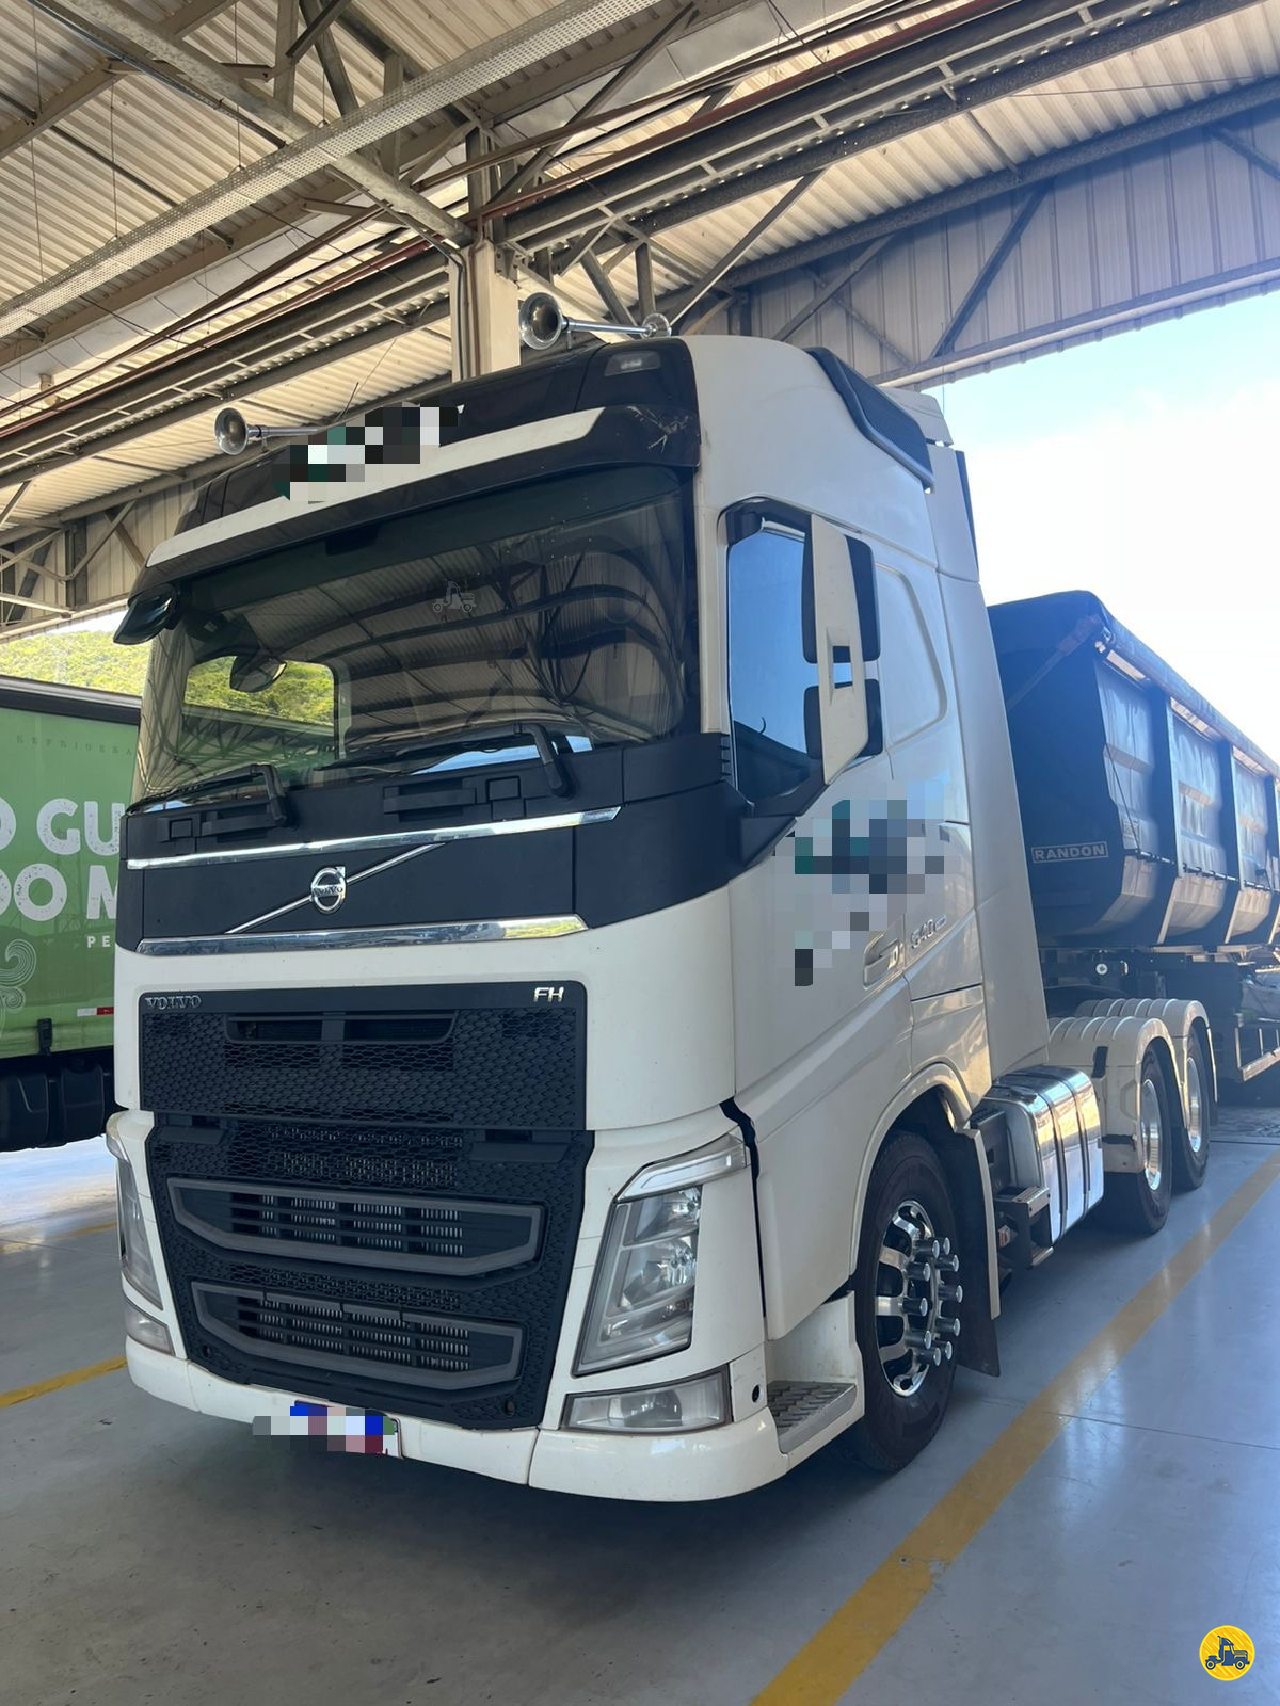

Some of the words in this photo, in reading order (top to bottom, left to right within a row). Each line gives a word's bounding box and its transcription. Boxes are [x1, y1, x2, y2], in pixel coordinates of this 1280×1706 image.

[1034, 843, 1105, 860] RANDON
[533, 986, 565, 1002] FH
[144, 995, 202, 1010] VOLVO
